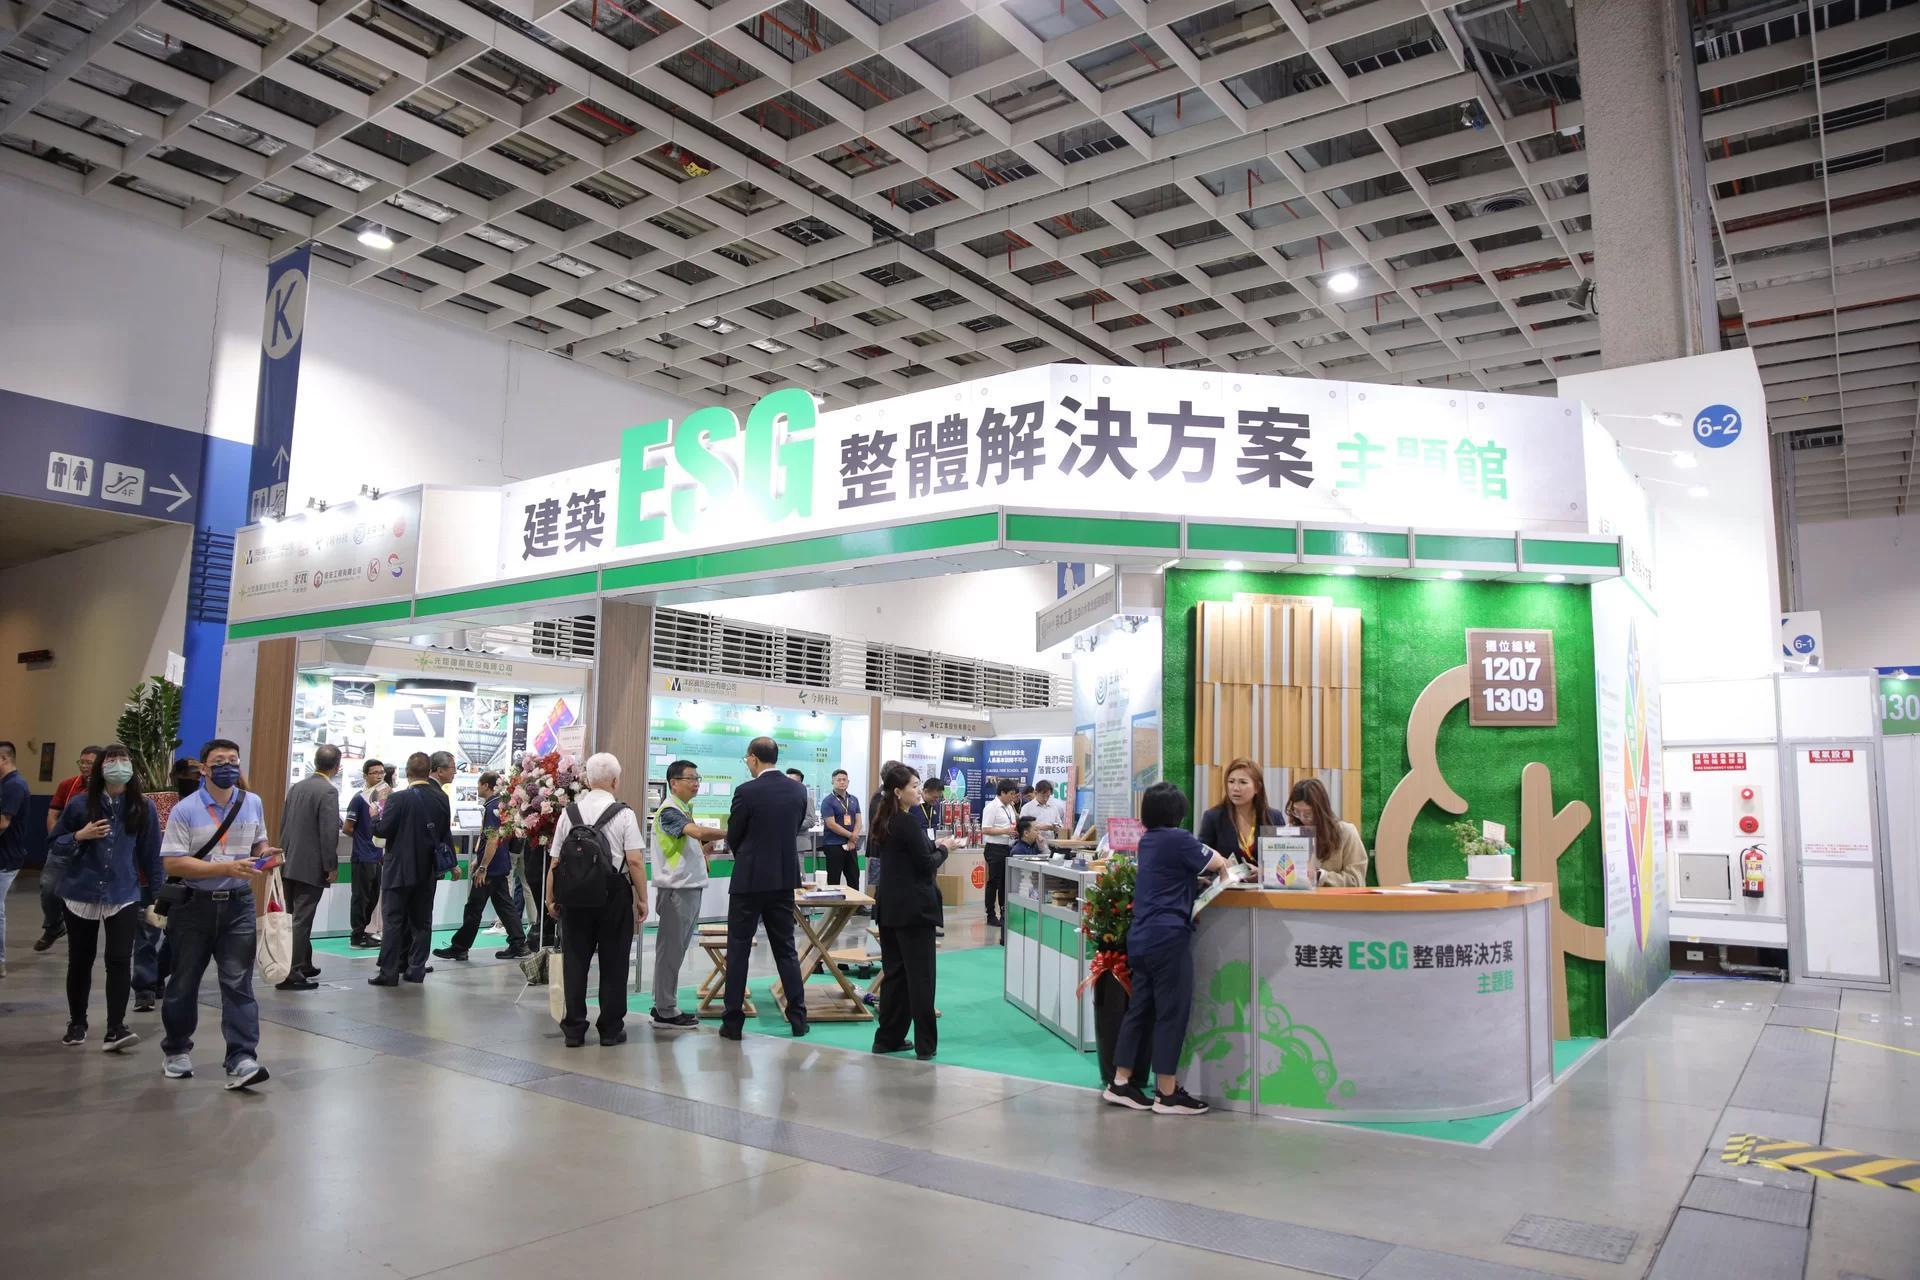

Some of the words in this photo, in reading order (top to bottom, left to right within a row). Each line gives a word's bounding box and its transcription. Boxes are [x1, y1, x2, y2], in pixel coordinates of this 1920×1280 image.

[272, 281, 298, 347] K
[1697, 414, 1739, 438] 6-2
[522, 489, 606, 561] 建築
[616, 388, 818, 548] ESG
[838, 396, 1314, 509] 整體解決方案
[122, 489, 135, 497] 4F
[1795, 639, 1813, 648] 6-1
[1481, 657, 1541, 681] 1207
[1483, 688, 1544, 711] 1309
[1295, 944, 1343, 969] 建築
[1348, 941, 1408, 970] ESG
[1413, 941, 1513, 969] 整體解決方案
[1476, 970, 1514, 994] 主題館
